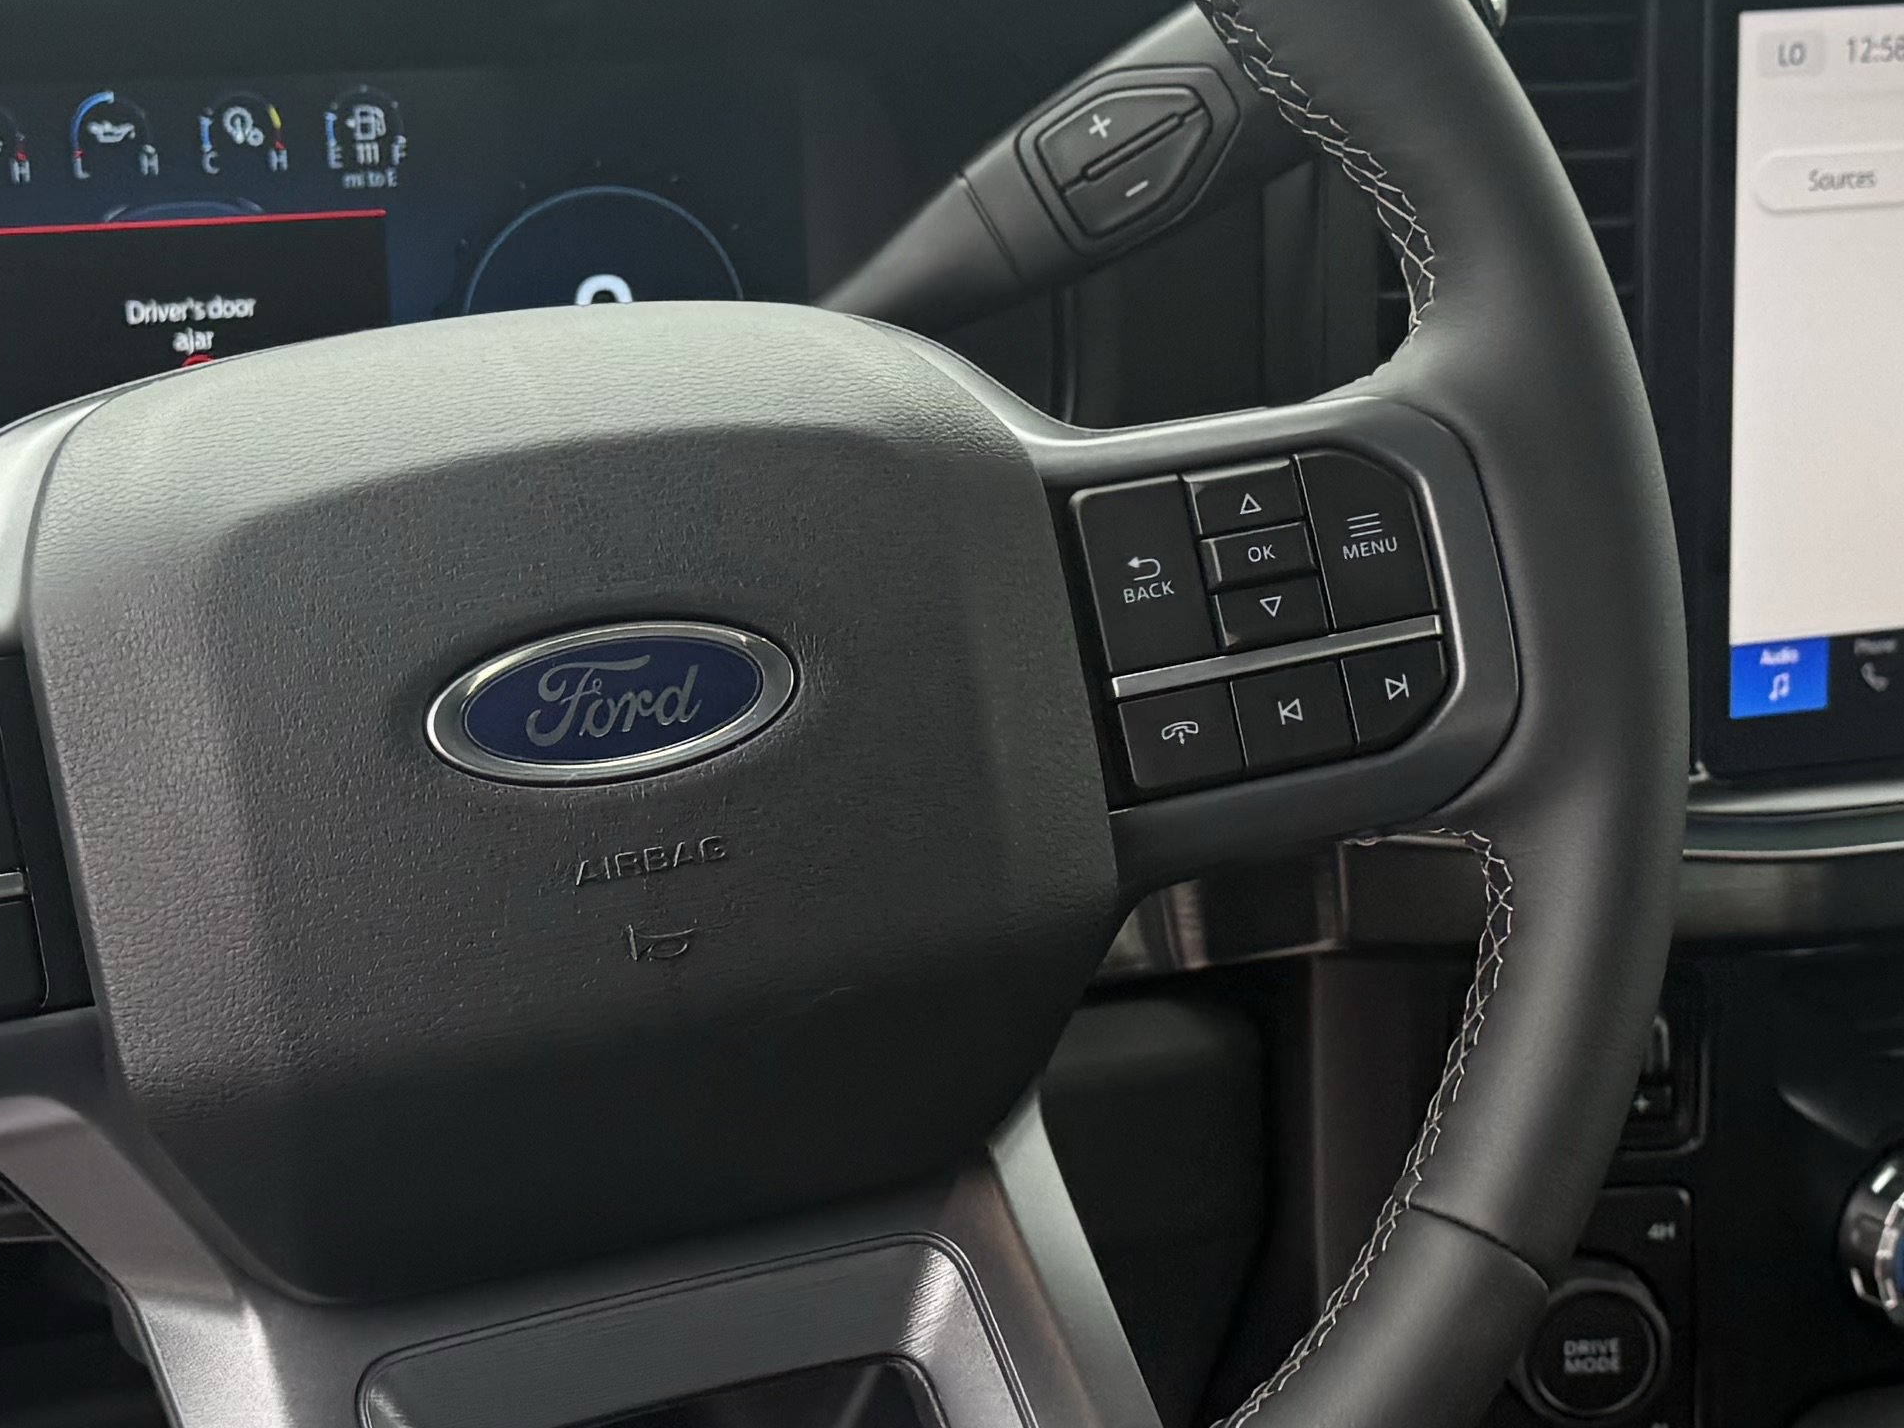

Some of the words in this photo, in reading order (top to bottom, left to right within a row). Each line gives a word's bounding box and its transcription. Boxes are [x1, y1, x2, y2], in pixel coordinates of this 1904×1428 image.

[1778, 40, 1807, 67] LO
[1808, 169, 1877, 192] Sources
[124, 296, 206, 325] Driver's
[206, 293, 257, 320] door
[172, 326, 215, 355] ajar
[1247, 544, 1276, 563] OK
[1342, 537, 1398, 560] MENU
[1123, 580, 1175, 604] BACK
[1759, 647, 1799, 666] Audio
[525, 653, 702, 748] Ford
[575, 835, 729, 887] AIRBAG
[1563, 1337, 1619, 1357] DRIVE
[1563, 1356, 1619, 1374] MODE
